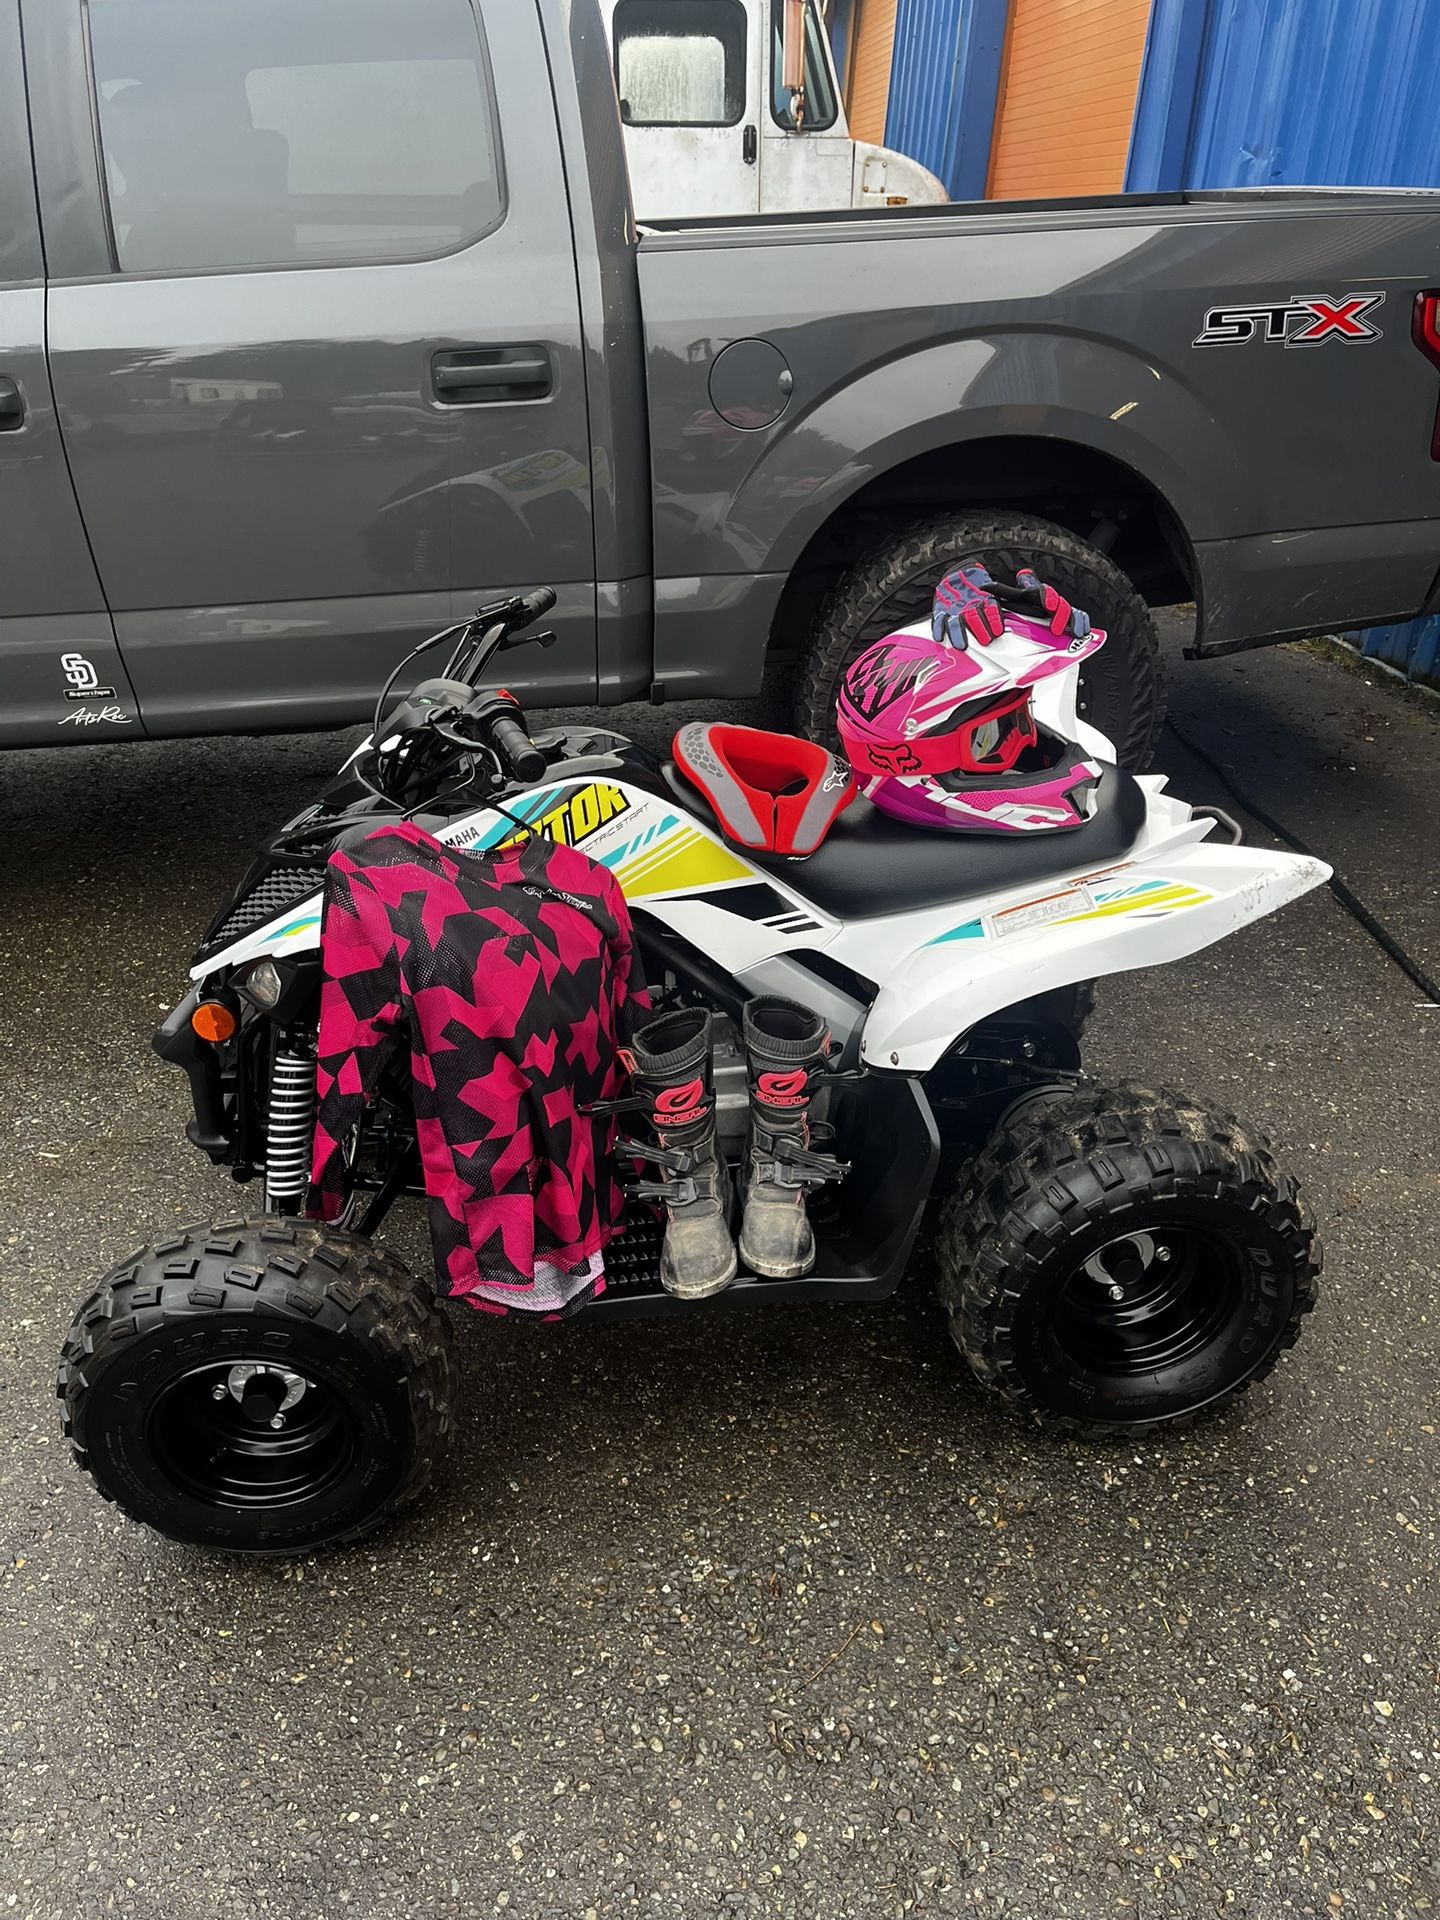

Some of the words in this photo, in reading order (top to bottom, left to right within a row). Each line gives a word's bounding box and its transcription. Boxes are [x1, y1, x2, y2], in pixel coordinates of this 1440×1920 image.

[1192, 291, 1386, 348] STX
[444, 826, 480, 847] MAHA
[1238, 1246, 1280, 1354] DURO
